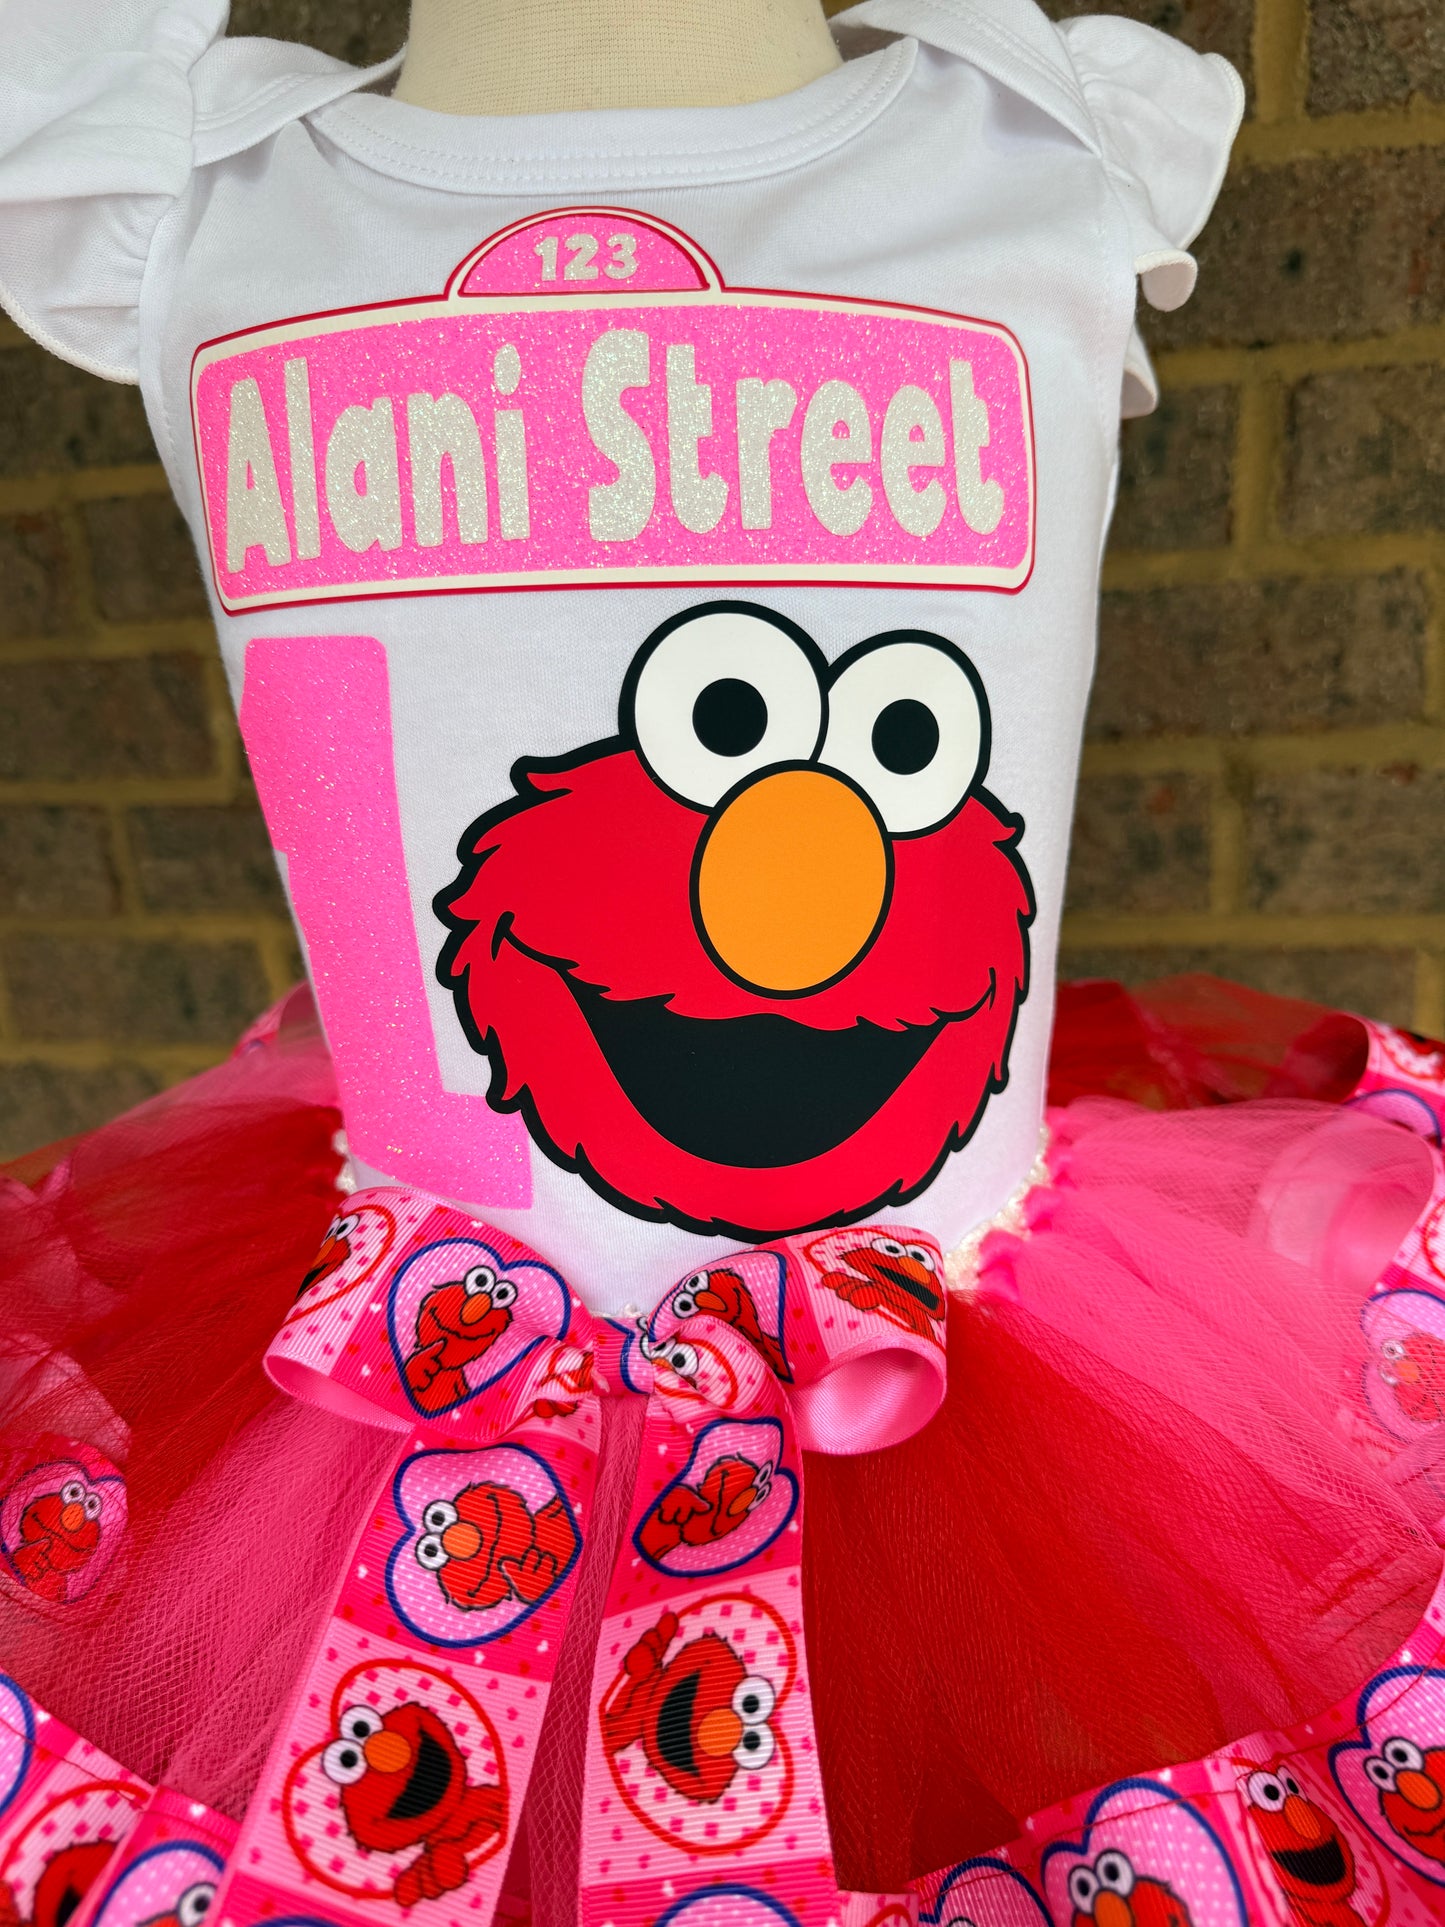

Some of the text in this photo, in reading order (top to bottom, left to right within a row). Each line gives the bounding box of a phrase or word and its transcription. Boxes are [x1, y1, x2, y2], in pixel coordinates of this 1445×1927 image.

[534, 234, 640, 282] 123
[226, 328, 1003, 574] Alani Street
